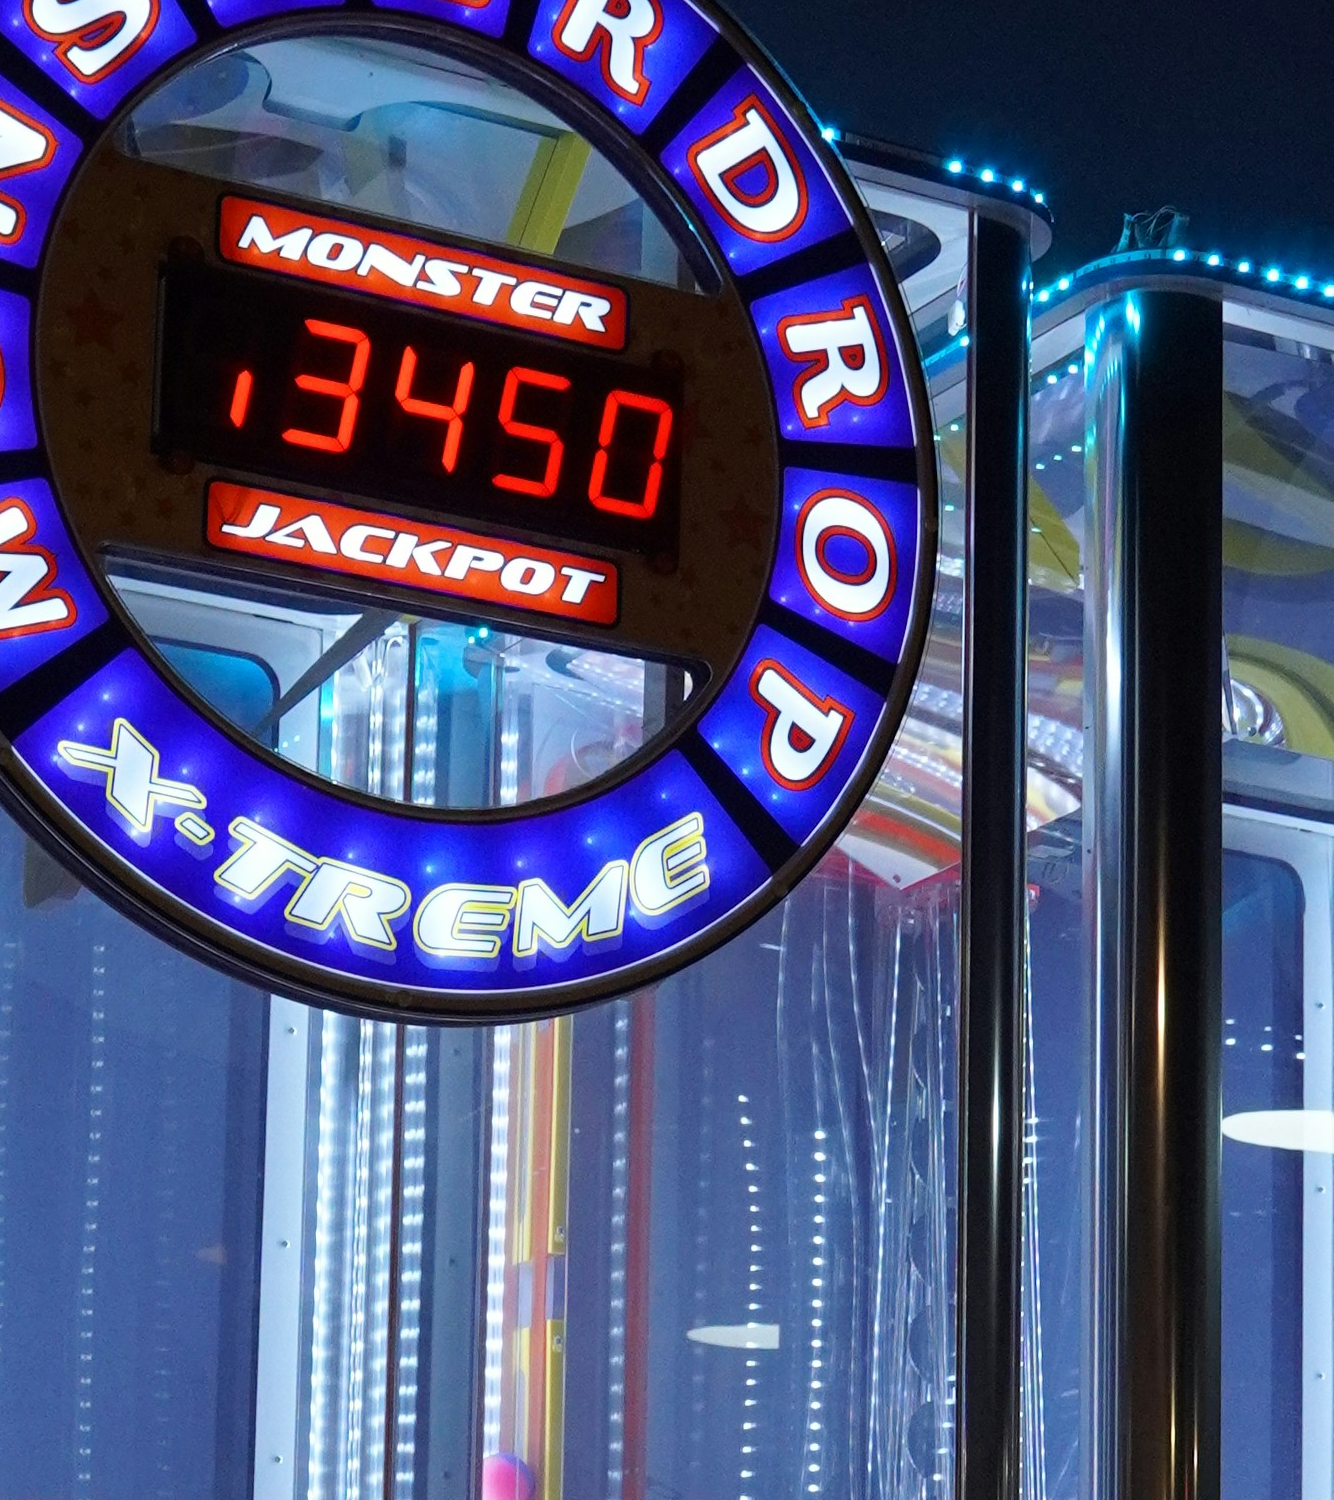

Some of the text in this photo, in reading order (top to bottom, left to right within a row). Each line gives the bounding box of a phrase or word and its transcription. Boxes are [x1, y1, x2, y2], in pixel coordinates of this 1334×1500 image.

[235, 215, 614, 334] MONSTER
[687, 95, 897, 793] DROP
[220, 500, 607, 607] JACKPOT
[57, 718, 709, 960] X-TREME
